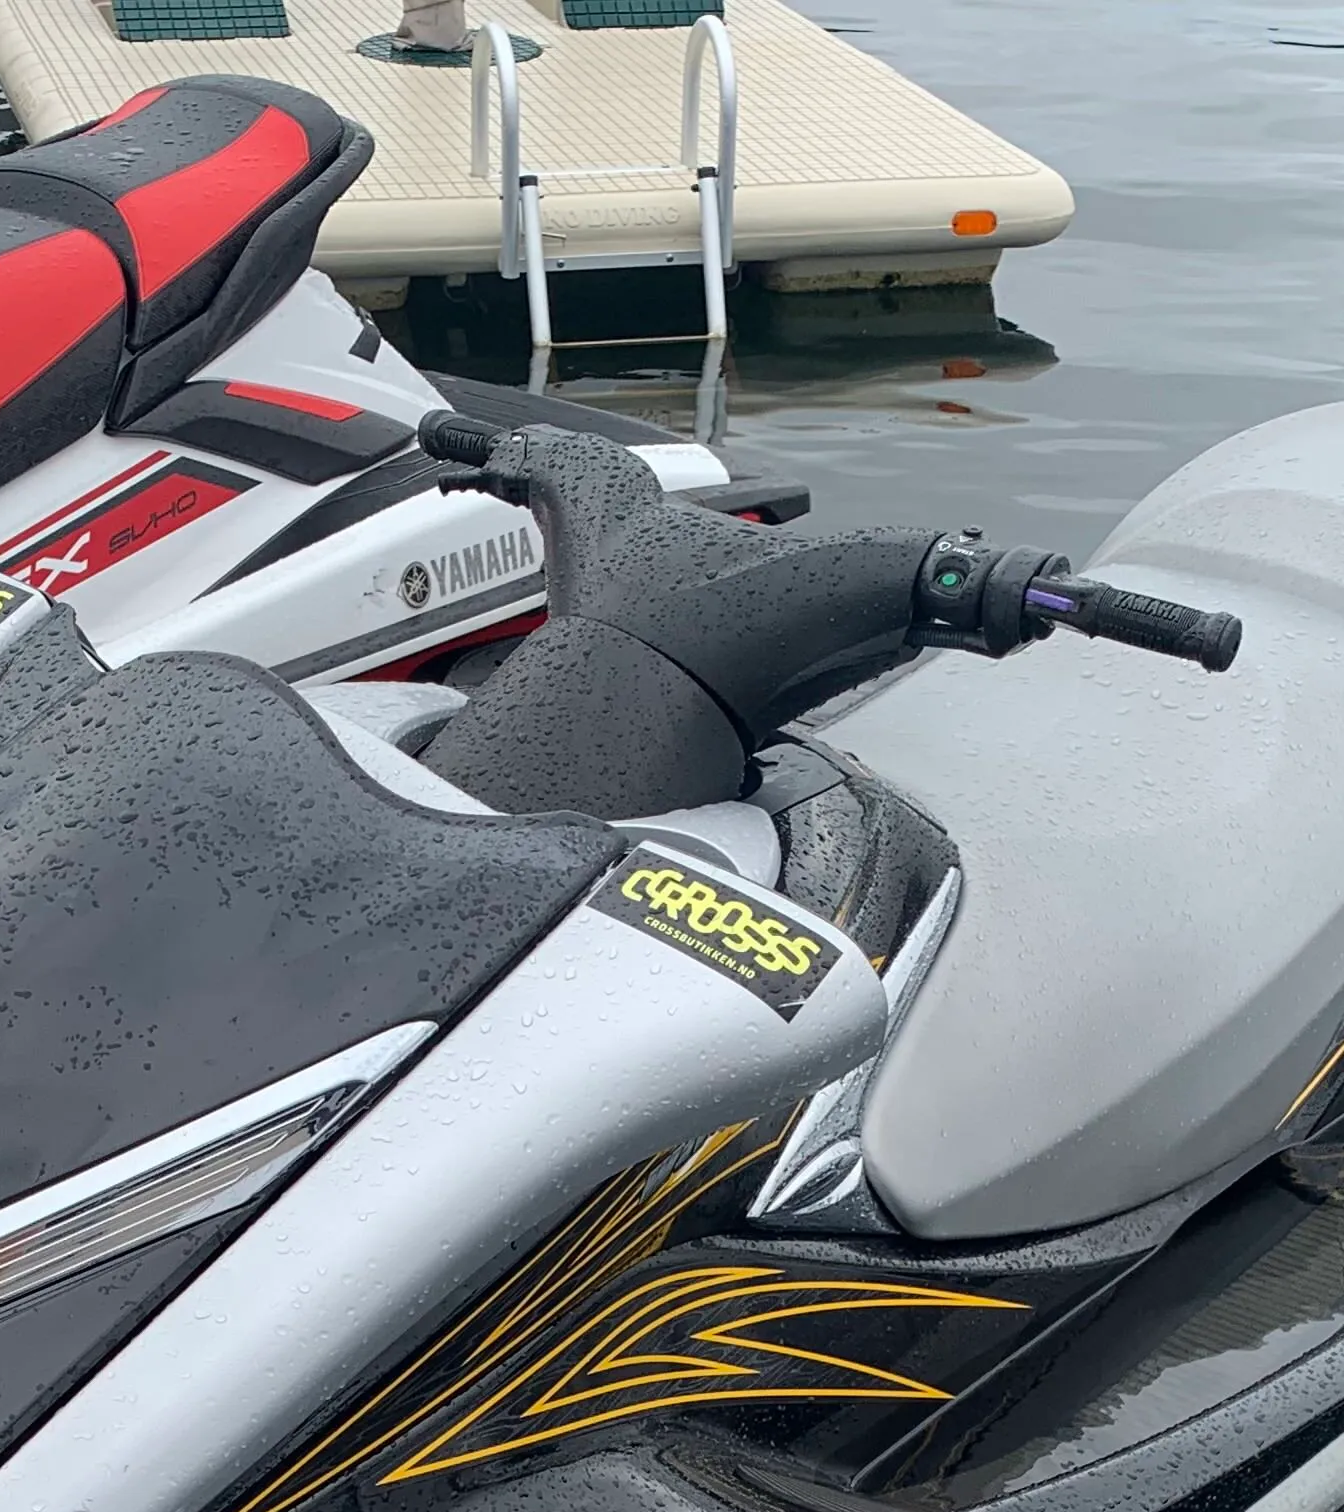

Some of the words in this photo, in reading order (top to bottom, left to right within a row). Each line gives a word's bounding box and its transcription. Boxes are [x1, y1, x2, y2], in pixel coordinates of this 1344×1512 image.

[542, 208, 581, 230] NO
[586, 206, 681, 228] DIVING
[109, 490, 198, 555] SVHO
[430, 527, 535, 599] YAMAHA
[1113, 591, 1183, 622] YAMAHA
